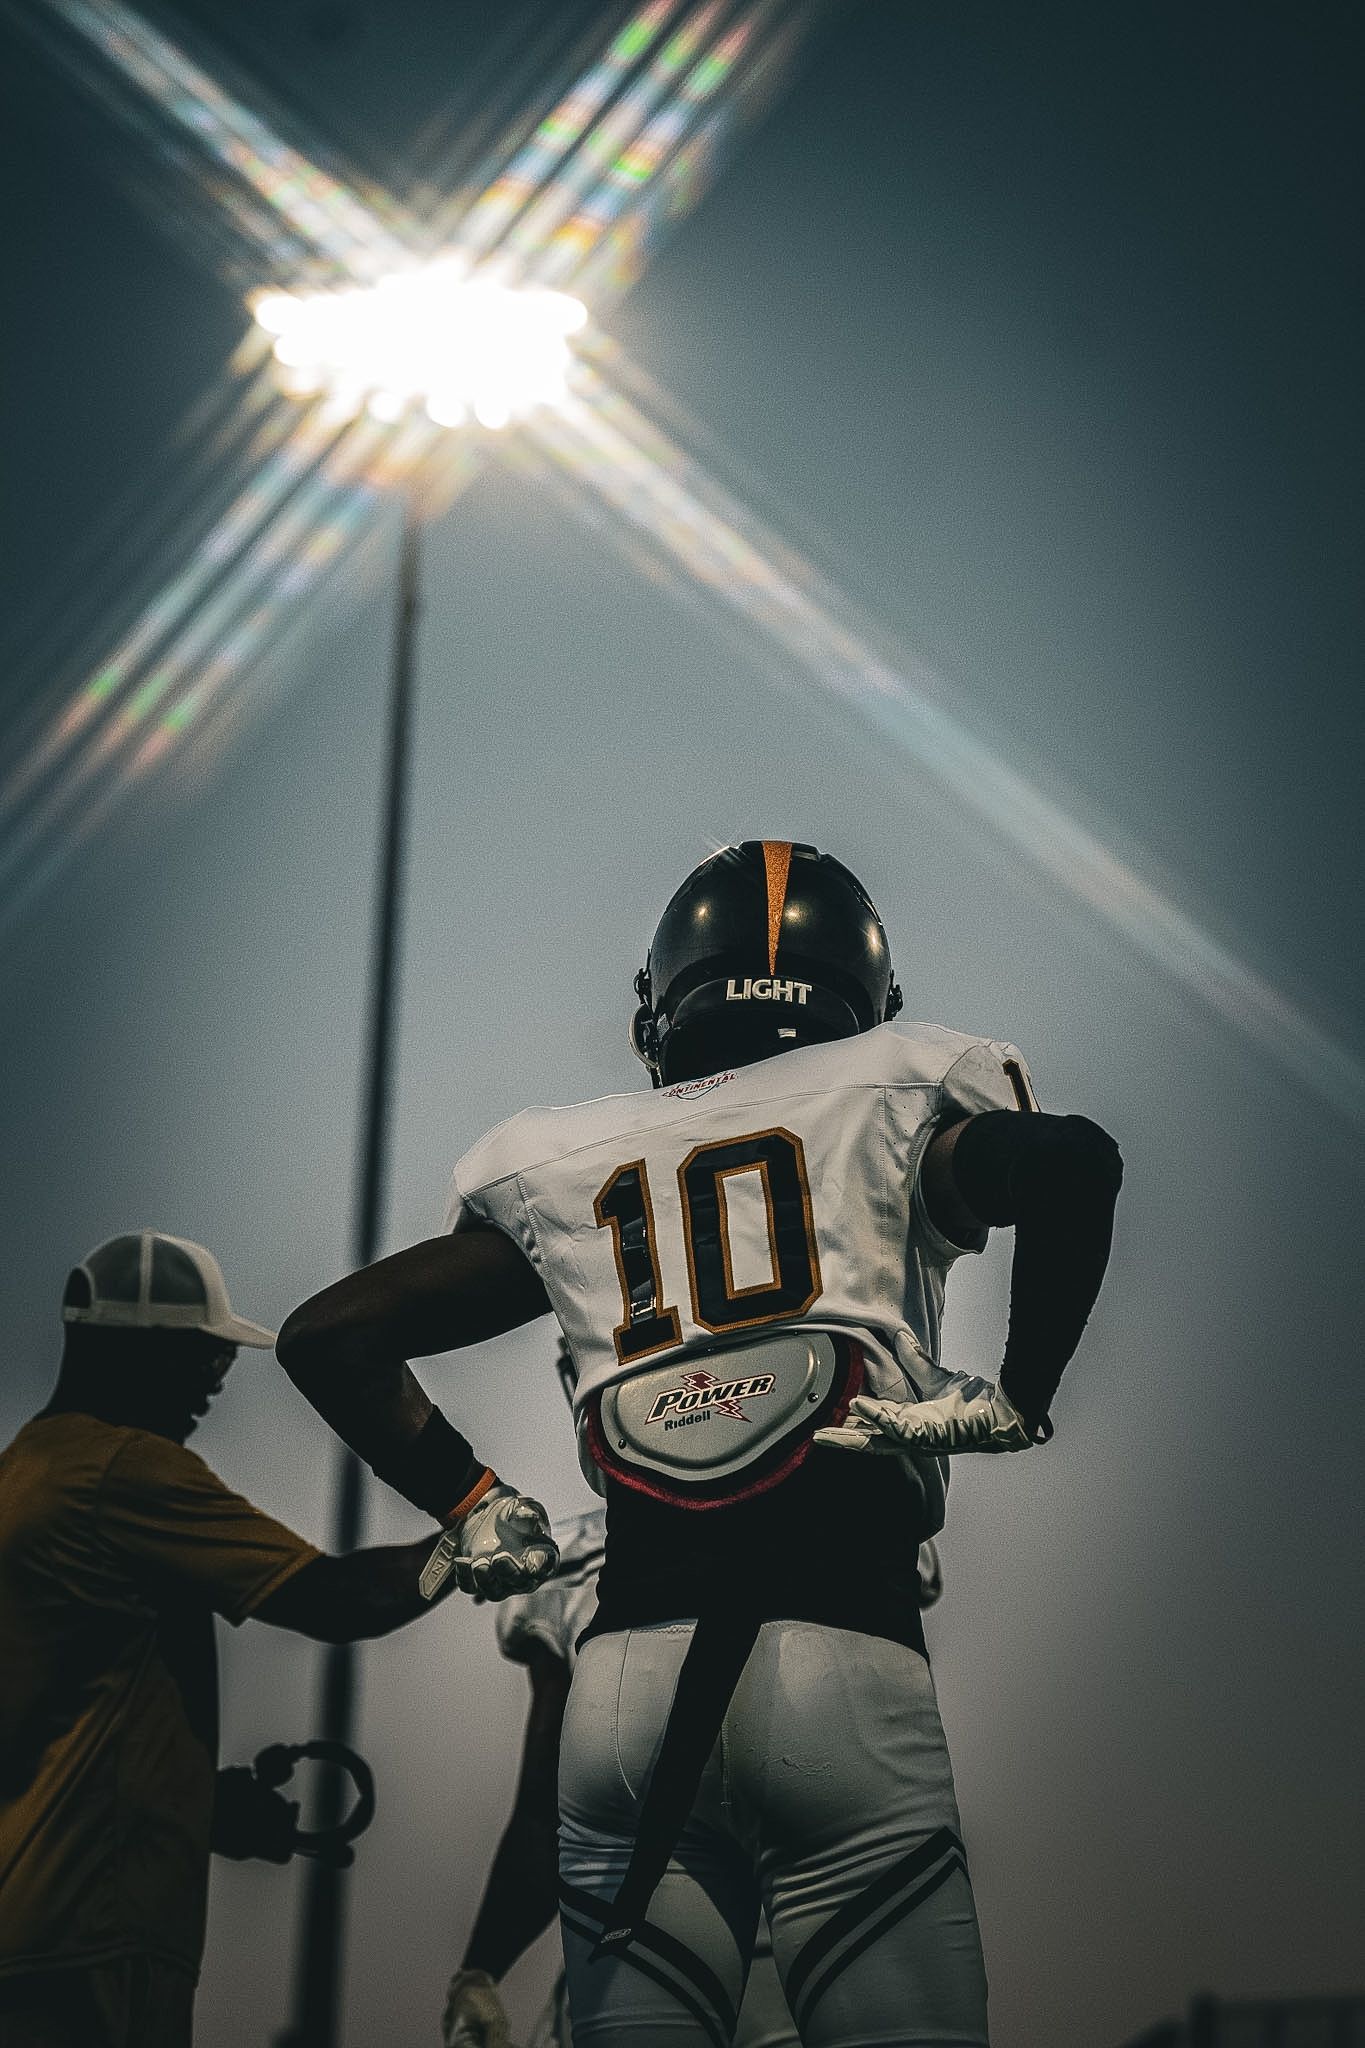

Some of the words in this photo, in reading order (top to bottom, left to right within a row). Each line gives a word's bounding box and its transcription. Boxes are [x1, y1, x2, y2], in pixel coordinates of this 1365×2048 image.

[726, 979, 812, 1004] LIGHT
[593, 1126, 823, 1366] 10
[648, 1375, 775, 1421] POWER
[664, 1410, 711, 1431] Riddell
